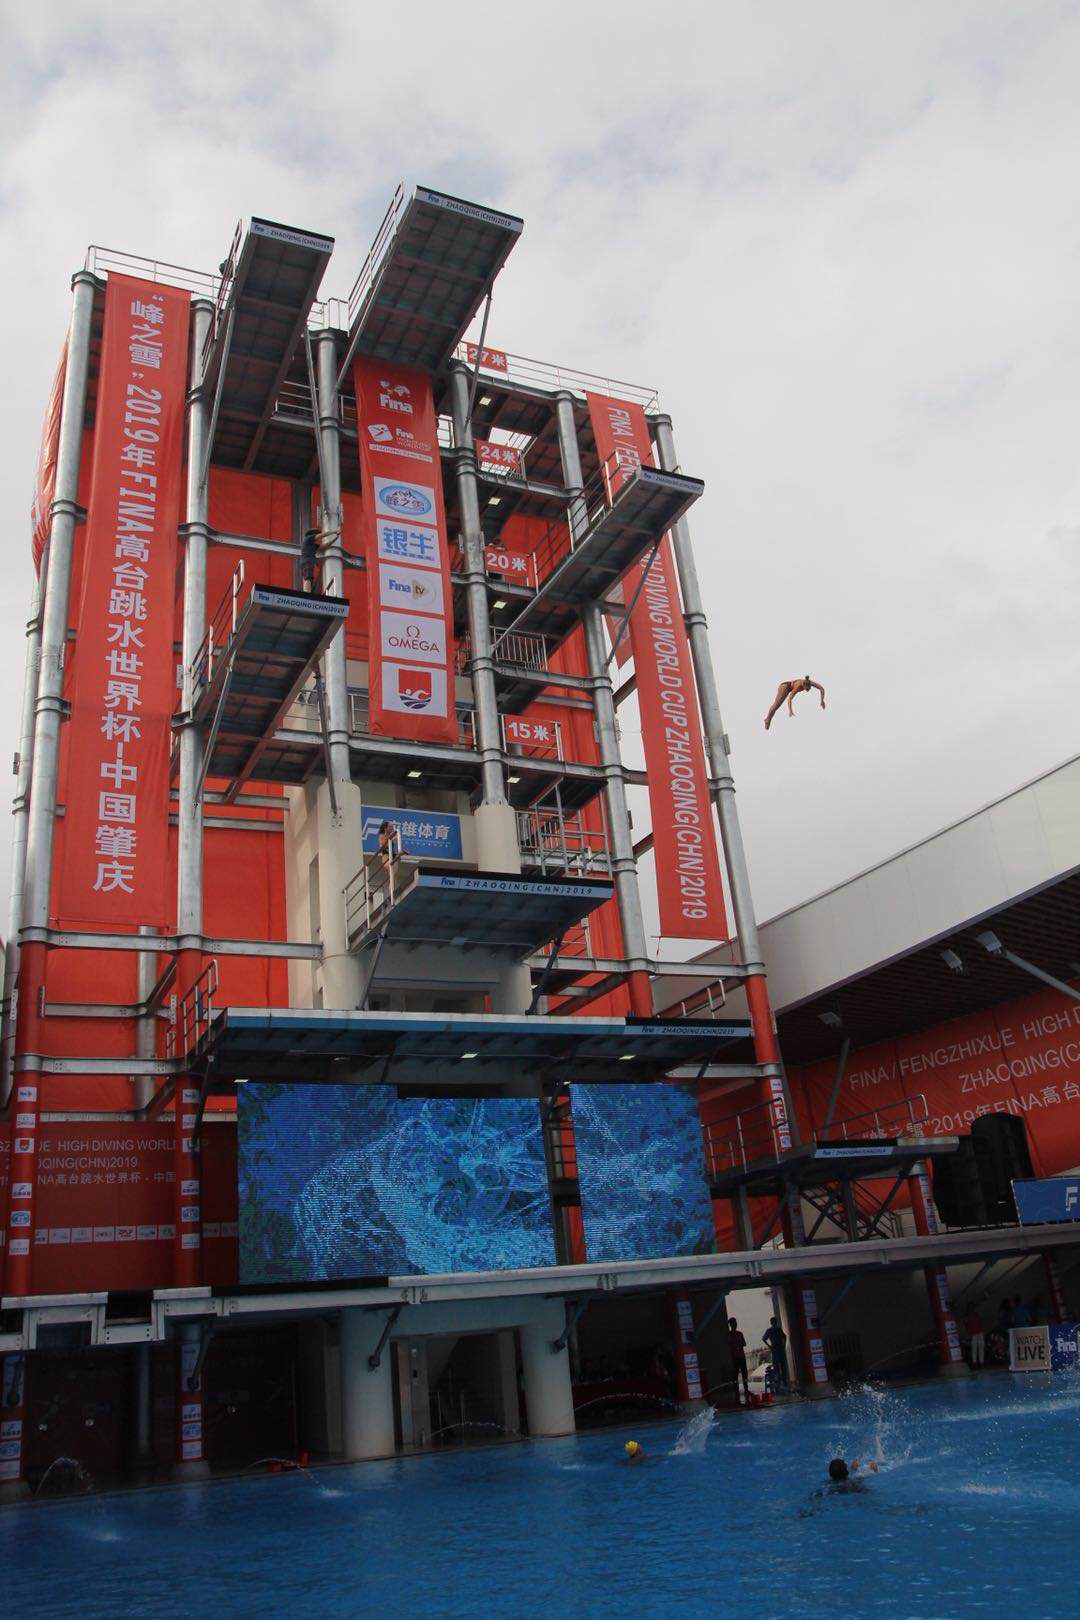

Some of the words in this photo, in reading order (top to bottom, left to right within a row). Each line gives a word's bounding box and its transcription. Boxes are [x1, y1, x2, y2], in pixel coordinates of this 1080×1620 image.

[469, 347, 506, 367] 27米
[608, 406, 634, 436] FINA
[480, 445, 516, 464] 24米
[486, 552, 527, 572] 20米
[388, 635, 440, 653] OMEGA
[651, 626, 683, 689] WORLD
[660, 690, 688, 729] CUP
[508, 721, 550, 741] 15米
[665, 728, 708, 919] ZHAOQING(CHN)2019
[850, 1066, 890, 1091] FINA
[1022, 1012, 1072, 1041] HIGH
[58, 1140, 90, 1151] HIGH
[92, 1140, 134, 1151] DIVING
[137, 1139, 176, 1151] WORL
[38, 1156, 138, 1169] QING(CHN)2019
[1017, 1346, 1045, 1360] LIVE
